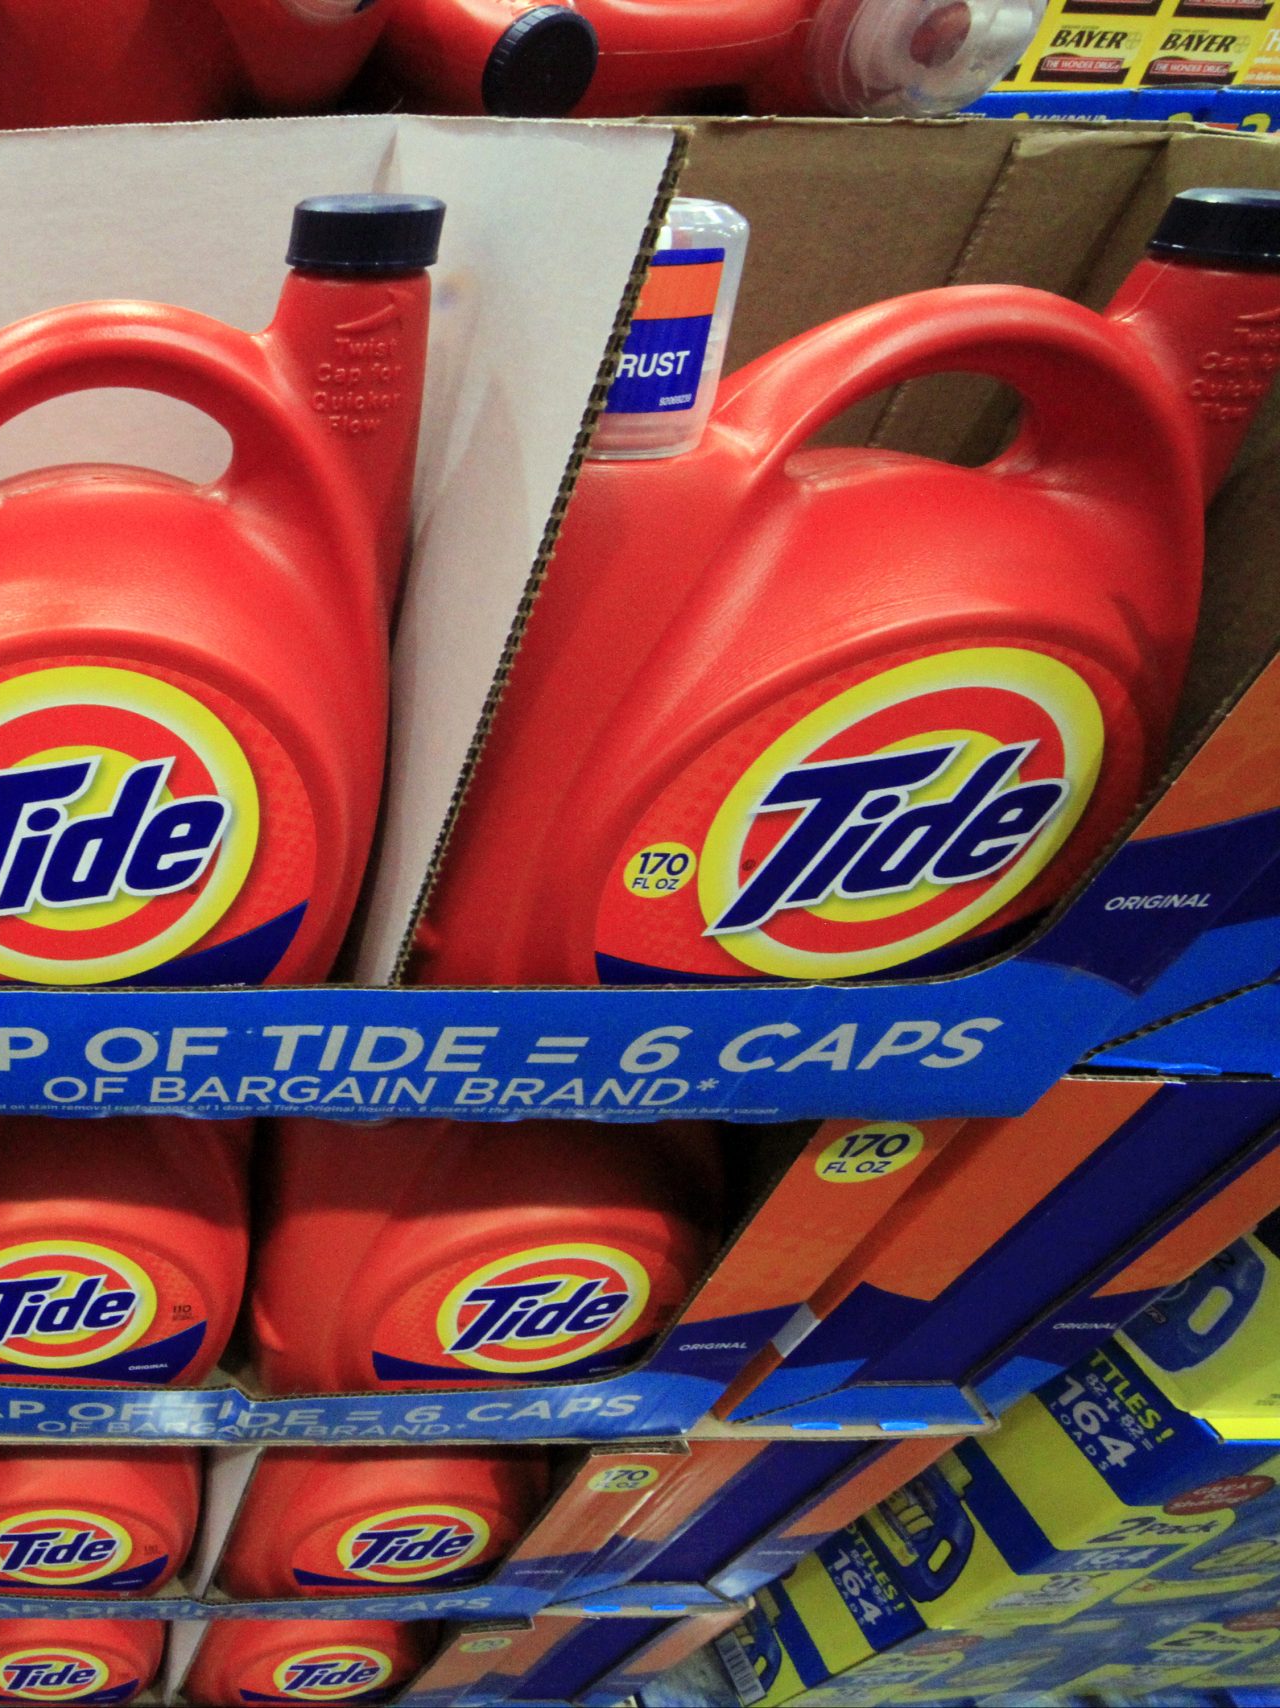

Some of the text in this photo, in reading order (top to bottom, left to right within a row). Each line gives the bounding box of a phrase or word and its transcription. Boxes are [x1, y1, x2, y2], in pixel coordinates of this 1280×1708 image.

[1050, 29, 1129, 49] BAYER
[1160, 33, 1238, 53] BAYER
[318, 362, 361, 385] Cap
[615, 350, 692, 379] RUST
[701, 739, 1069, 937] Tide
[636, 852, 689, 876] 170
[632, 877, 680, 890] FL OZ
[1104, 891, 1212, 912] ORIGINAL
[85, 1026, 228, 1073] OF
[262, 1024, 501, 1073] TIDE
[526, 1036, 591, 1064] =
[619, 1025, 694, 1075] 6
[718, 1017, 1005, 1073] CAPS
[43, 1076, 128, 1103] OF
[149, 1076, 437, 1104] BARGAIN
[838, 1134, 910, 1158] 170
[822, 1160, 892, 1174] FL OZ
[441, 1277, 634, 1355] Tide
[678, 1341, 748, 1351] ORIGINAL
[68, 1401, 158, 1422] OF
[346, 1410, 384, 1422] =
[404, 1404, 444, 1424] 6
[466, 1394, 643, 1422] CAPS
[1088, 1347, 1175, 1443] TTLES!
[37, 1420, 93, 1434] OF
[107, 1420, 290, 1439] BARGAIN
[1057, 1374, 1137, 1468] 164
[1050, 1401, 1110, 1471] LOADS
[1086, 1516, 1157, 1543] 2
[343, 1525, 477, 1572] Tide
[833, 1548, 883, 1625] 164
[364, 1596, 493, 1614] CAPS
[3, 1662, 98, 1692] Tide
[279, 1660, 381, 1692] Tide
